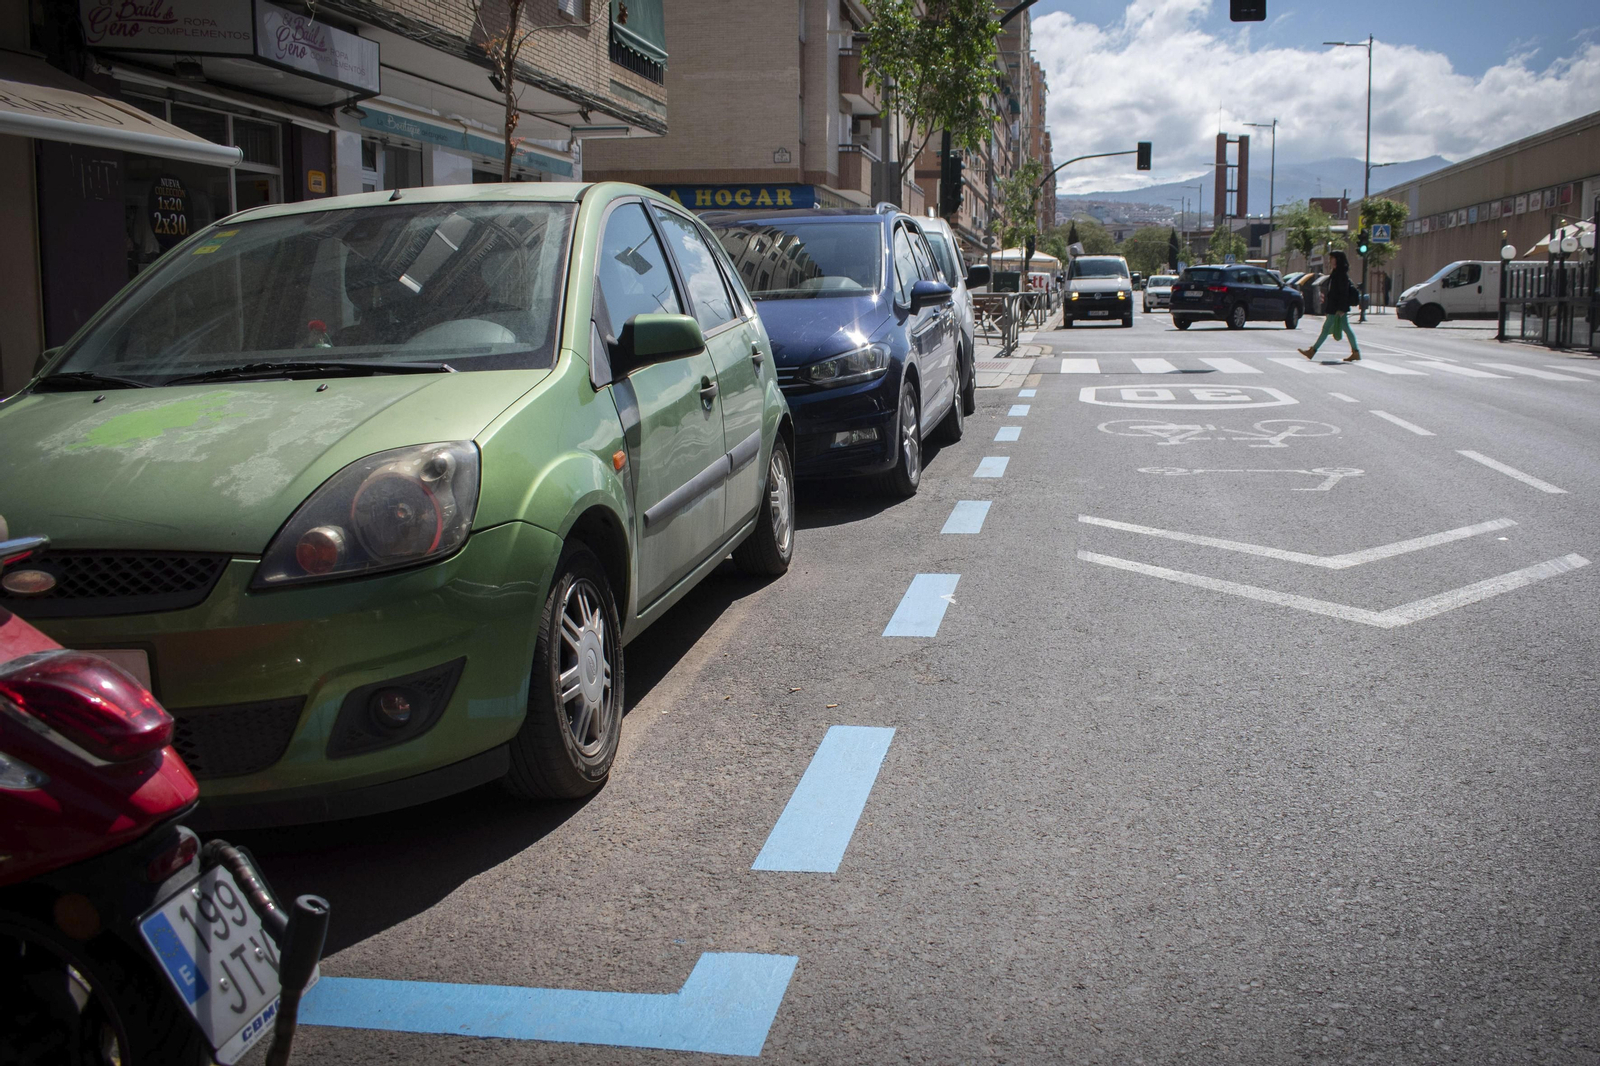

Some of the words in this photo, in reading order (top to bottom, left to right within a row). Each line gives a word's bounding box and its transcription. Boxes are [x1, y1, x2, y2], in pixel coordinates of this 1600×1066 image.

[163, 6, 175, 20] de
[87, 6, 143, 44] Geno
[183, 17, 218, 28] ROPA
[292, 17, 320, 45] Baúl
[148, 26, 251, 41] COMPLEMENTOS
[275, 26, 308, 60] Geno
[330, 48, 349, 60] ROPA
[310, 51, 367, 77] COMPLEMENTOS
[160, 177, 181, 189] NUEVA
[695, 188, 794, 206] HOGAR
[178, 964, 196, 986] E
